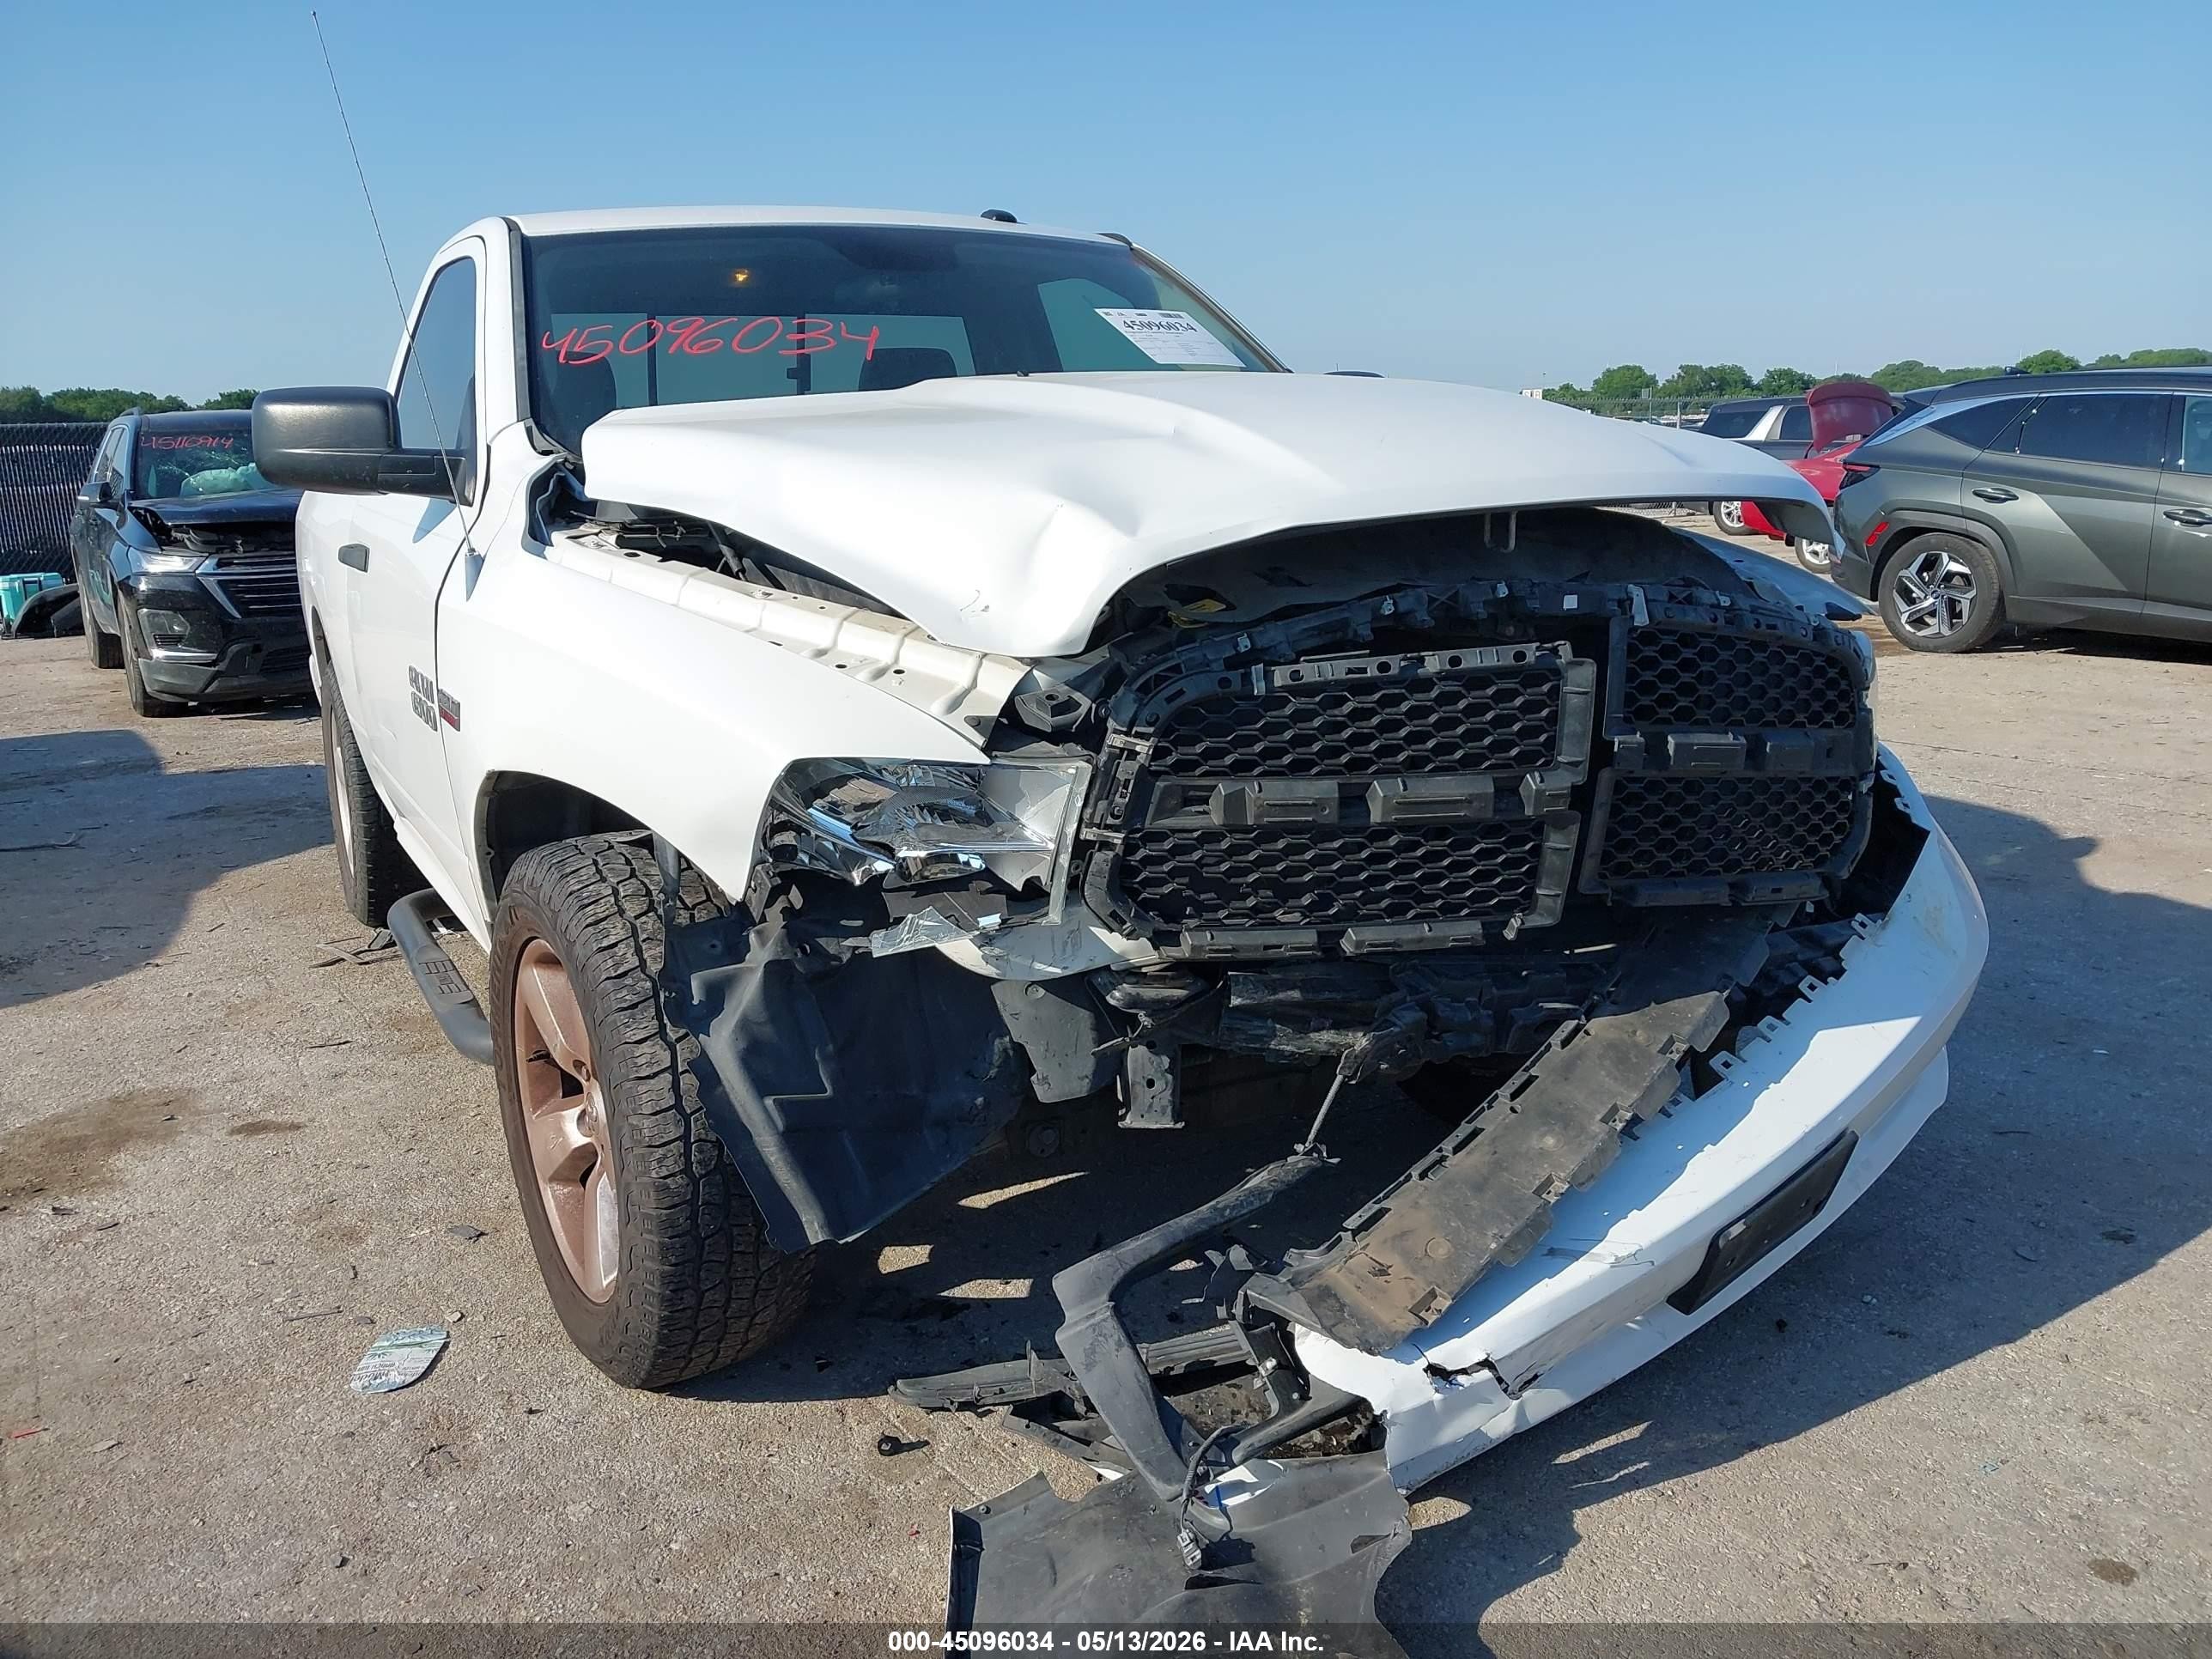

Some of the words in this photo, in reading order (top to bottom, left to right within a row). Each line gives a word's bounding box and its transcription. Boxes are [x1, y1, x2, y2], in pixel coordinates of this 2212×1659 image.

[1122, 320, 1198, 332] 45096034
[542, 315, 880, 365] 45096034
[141, 434, 234, 450] 45110914
